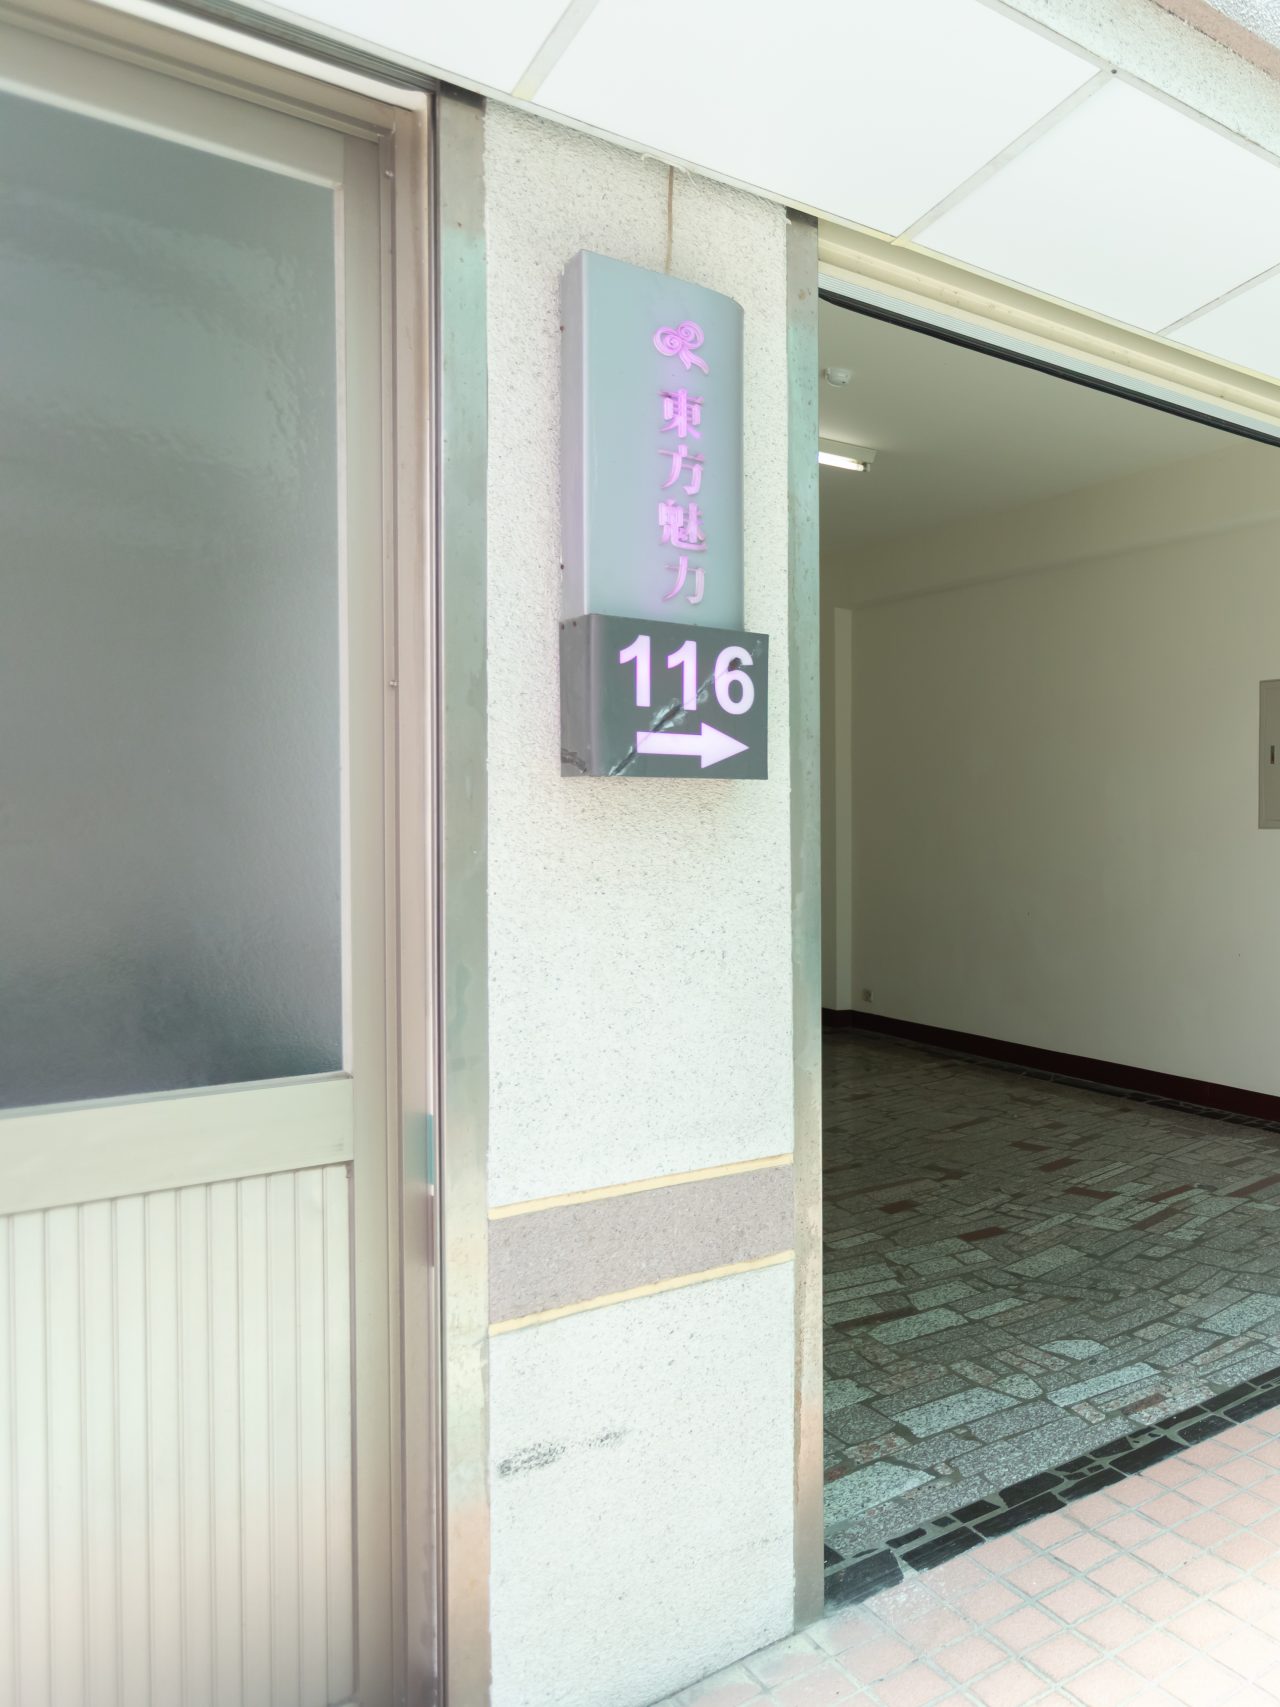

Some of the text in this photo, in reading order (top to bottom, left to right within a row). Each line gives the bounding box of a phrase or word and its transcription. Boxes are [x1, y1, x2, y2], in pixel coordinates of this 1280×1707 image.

[658, 389, 707, 605] 東方魅力
[619, 634, 755, 715] 116
